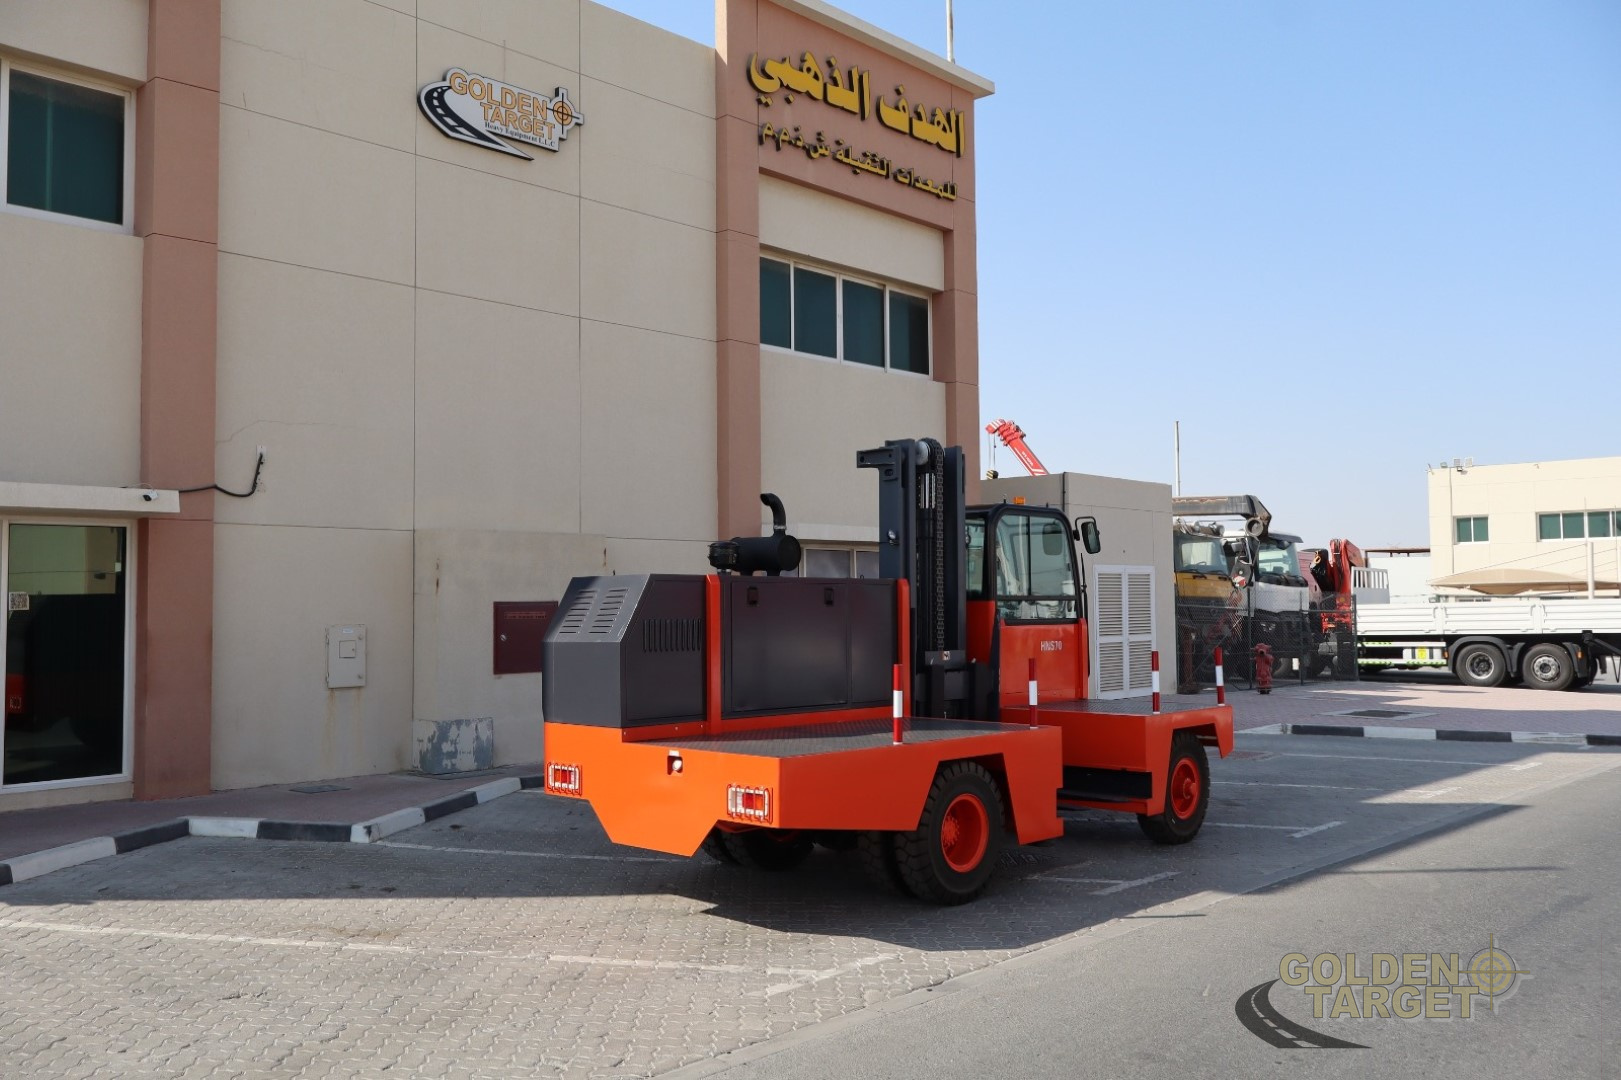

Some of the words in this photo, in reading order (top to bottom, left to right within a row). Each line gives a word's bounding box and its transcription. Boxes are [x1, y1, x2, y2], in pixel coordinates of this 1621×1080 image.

[449, 72, 547, 120] GOLDEN
[748, 50, 871, 121] الذهبي
[480, 102, 555, 140] TARGET
[877, 84, 965, 158] الهدف
[832, 138, 892, 180] الثقيلة
[893, 167, 959, 201] للمعدات
